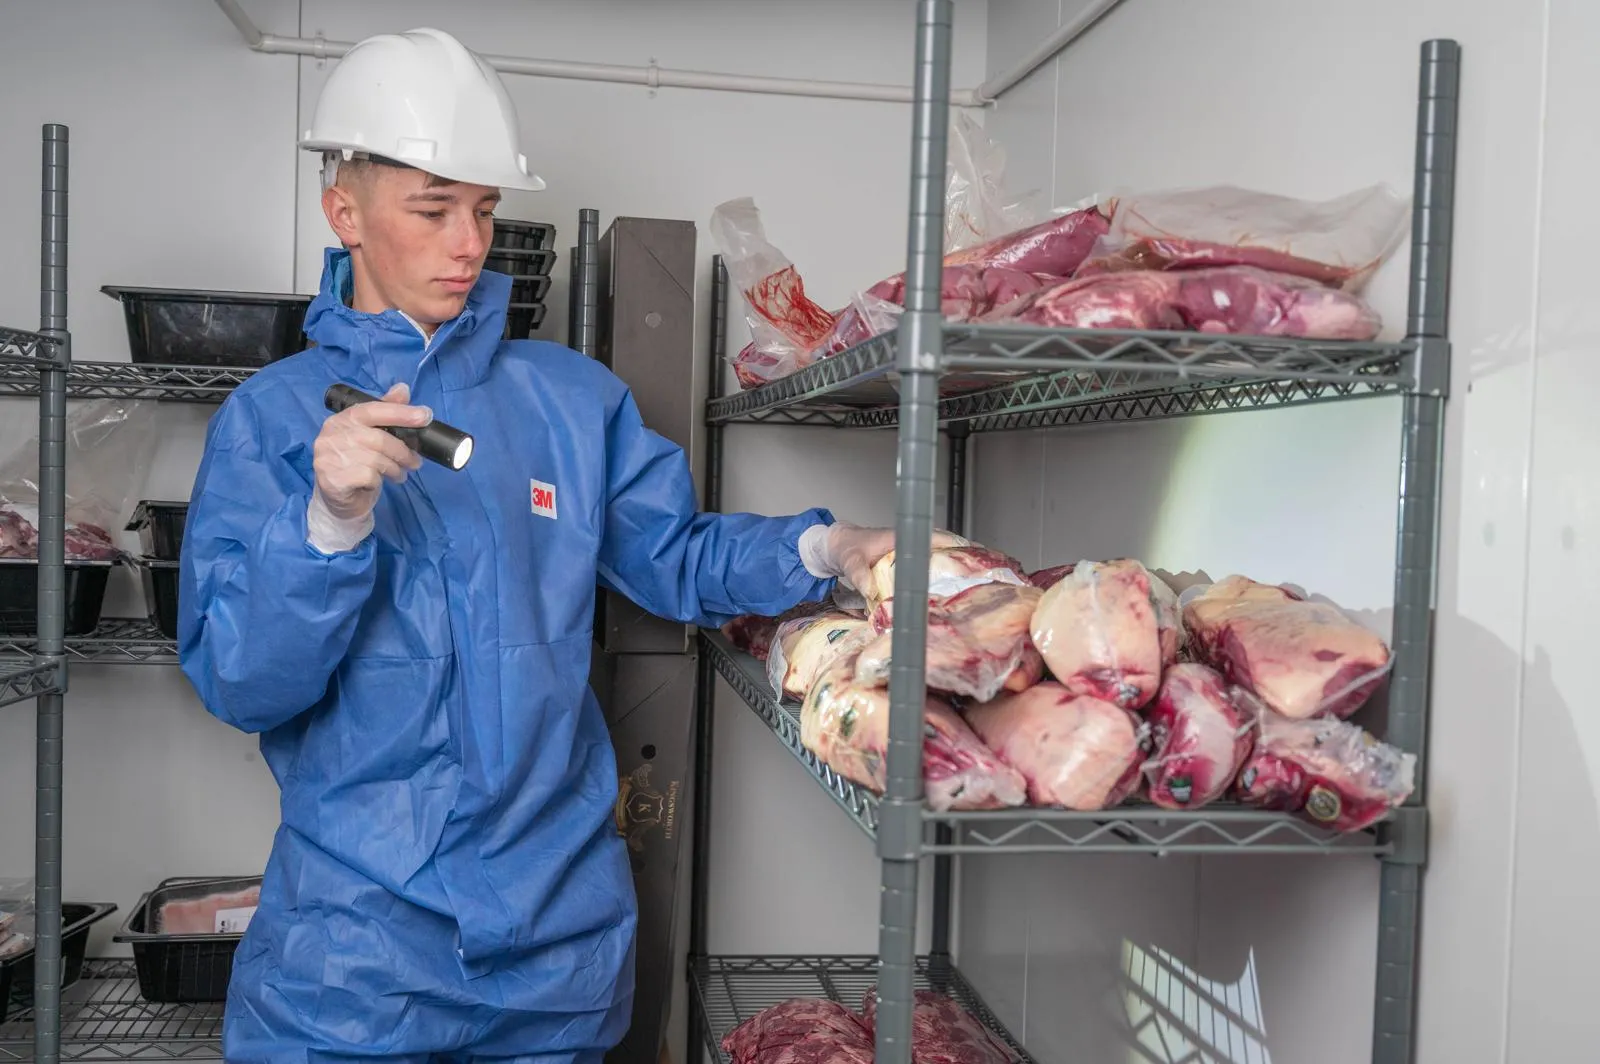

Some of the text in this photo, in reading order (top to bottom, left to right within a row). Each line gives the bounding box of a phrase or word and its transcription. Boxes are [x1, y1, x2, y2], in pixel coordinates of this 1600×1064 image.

[533, 487, 553, 509] 3M
[638, 803, 652, 813] K
[665, 780, 679, 839] KINGSWORTH
